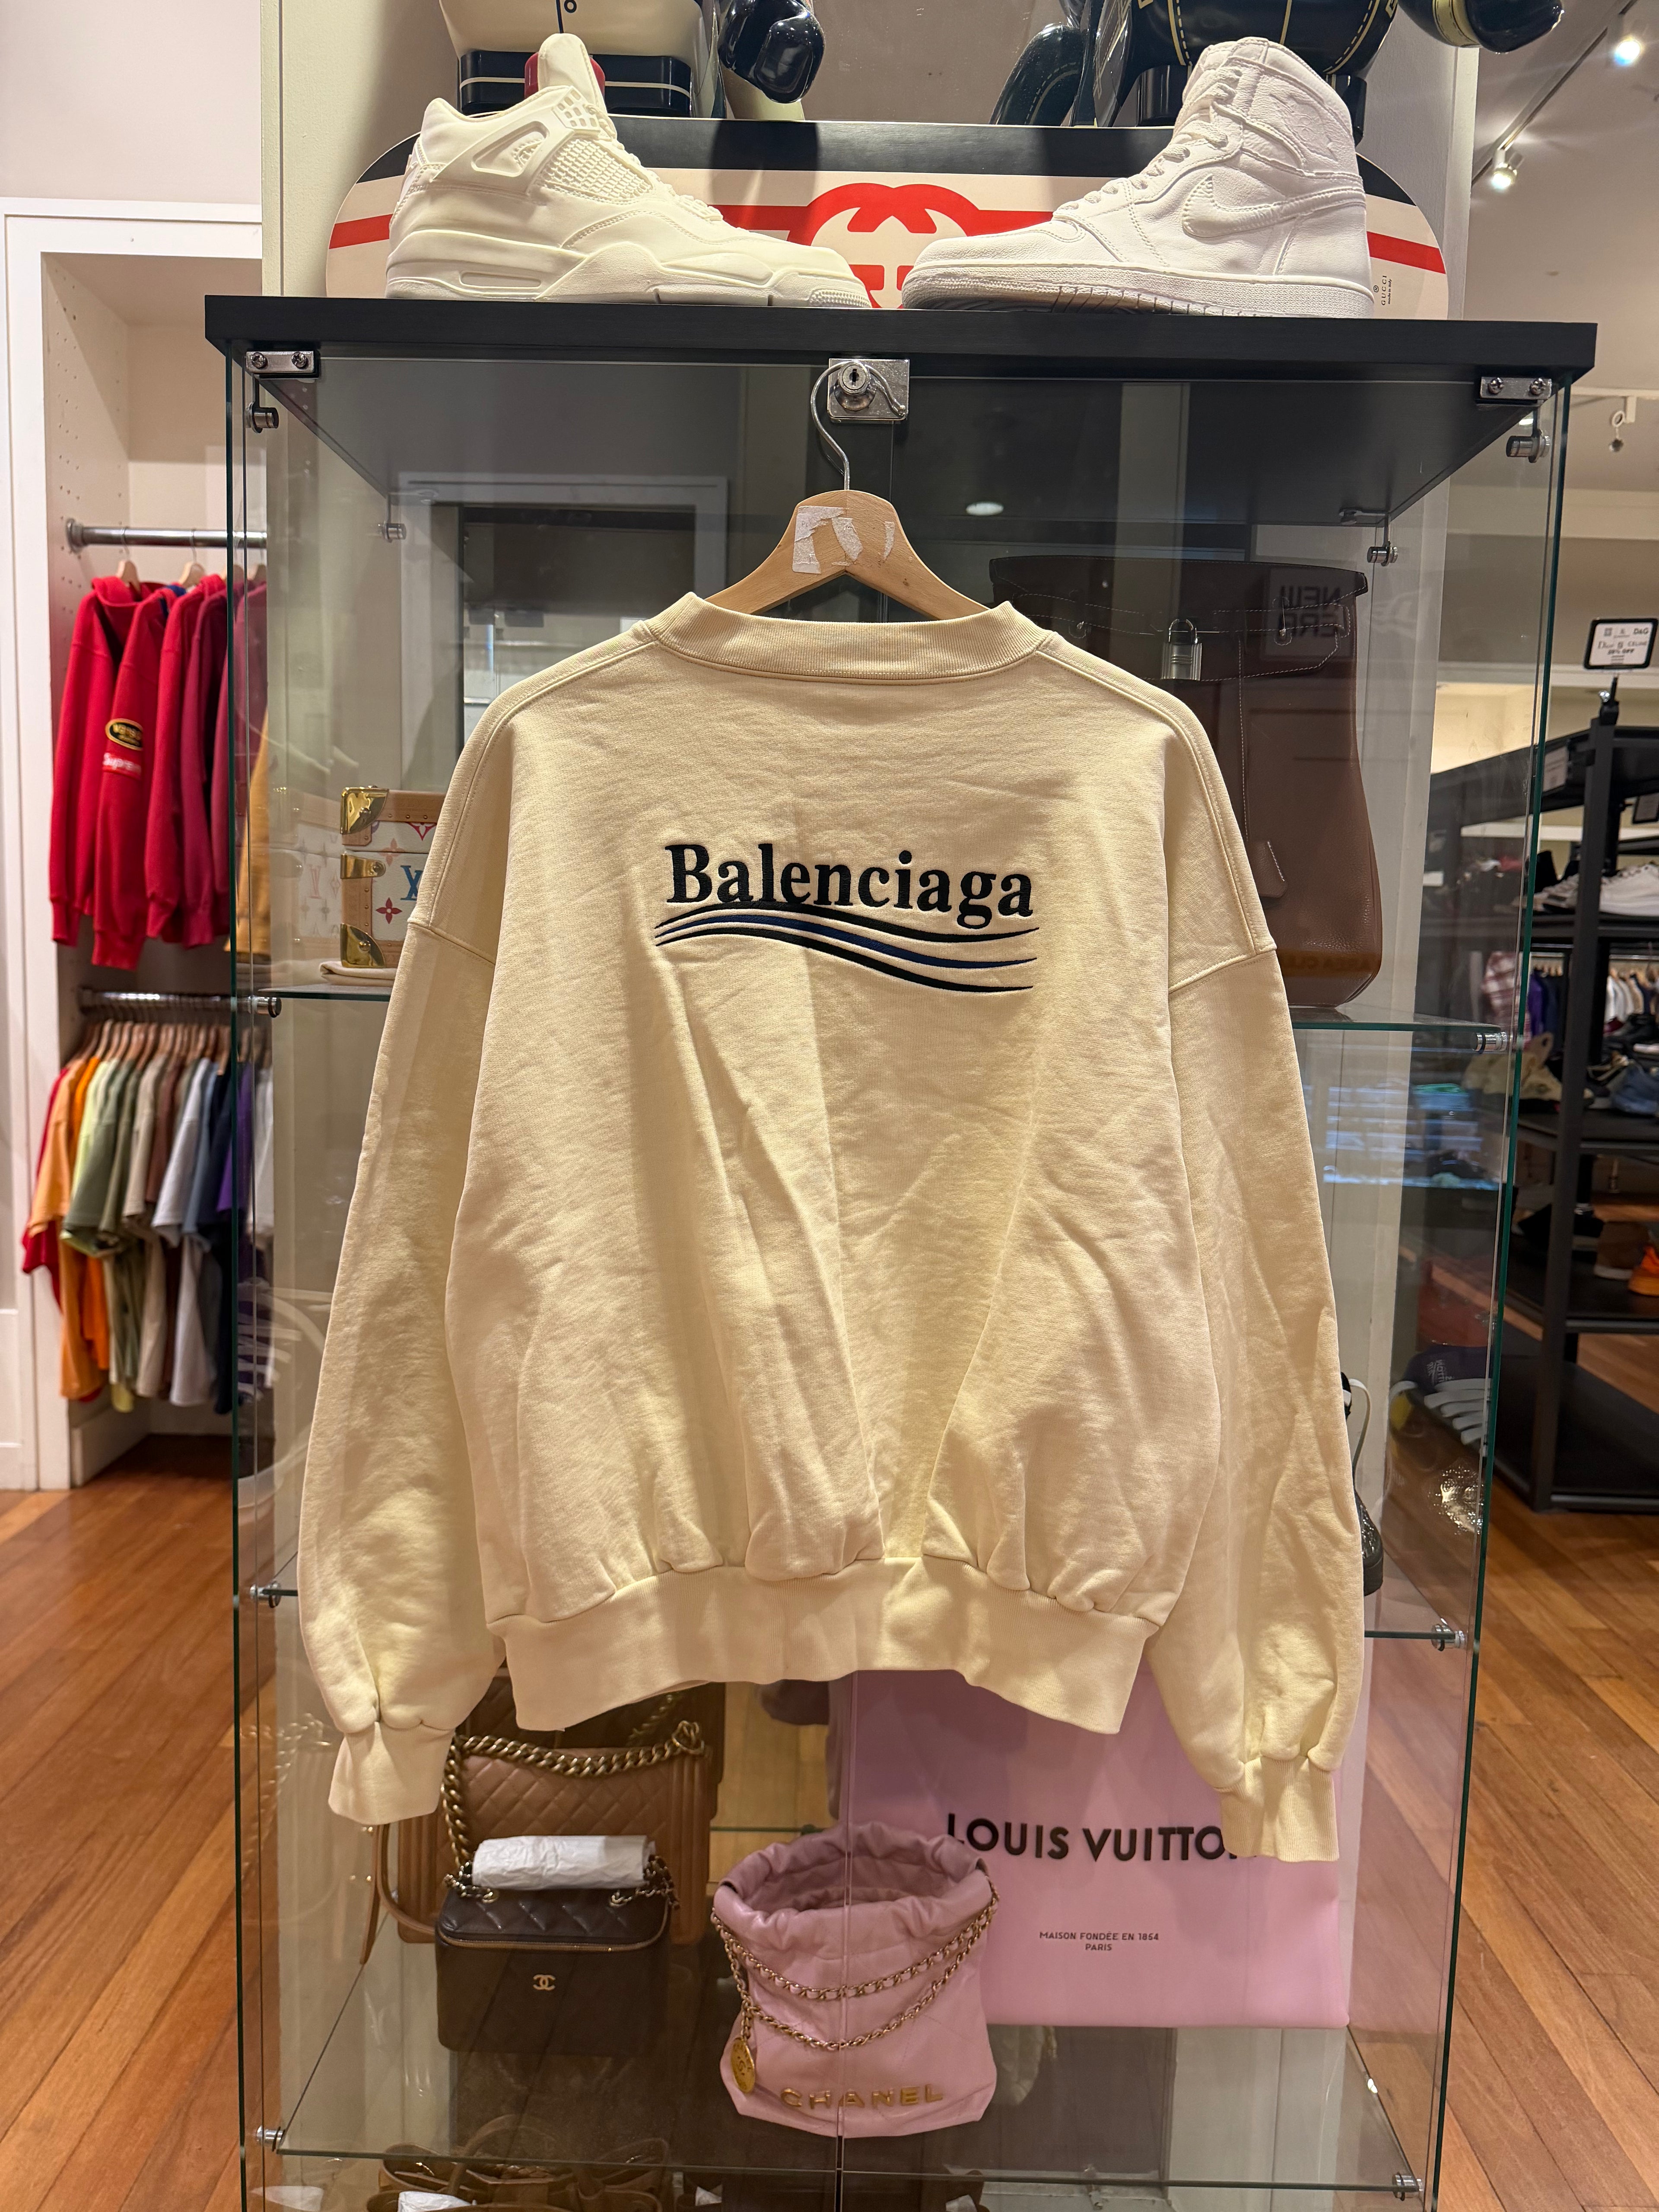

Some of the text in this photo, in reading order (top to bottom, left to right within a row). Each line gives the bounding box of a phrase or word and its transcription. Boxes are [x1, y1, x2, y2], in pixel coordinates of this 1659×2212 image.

[664, 843, 1033, 929] Balenciaga
[948, 1813, 1257, 1862] LOUIS VUITTO
[781, 2084, 944, 2110] CHANEL
